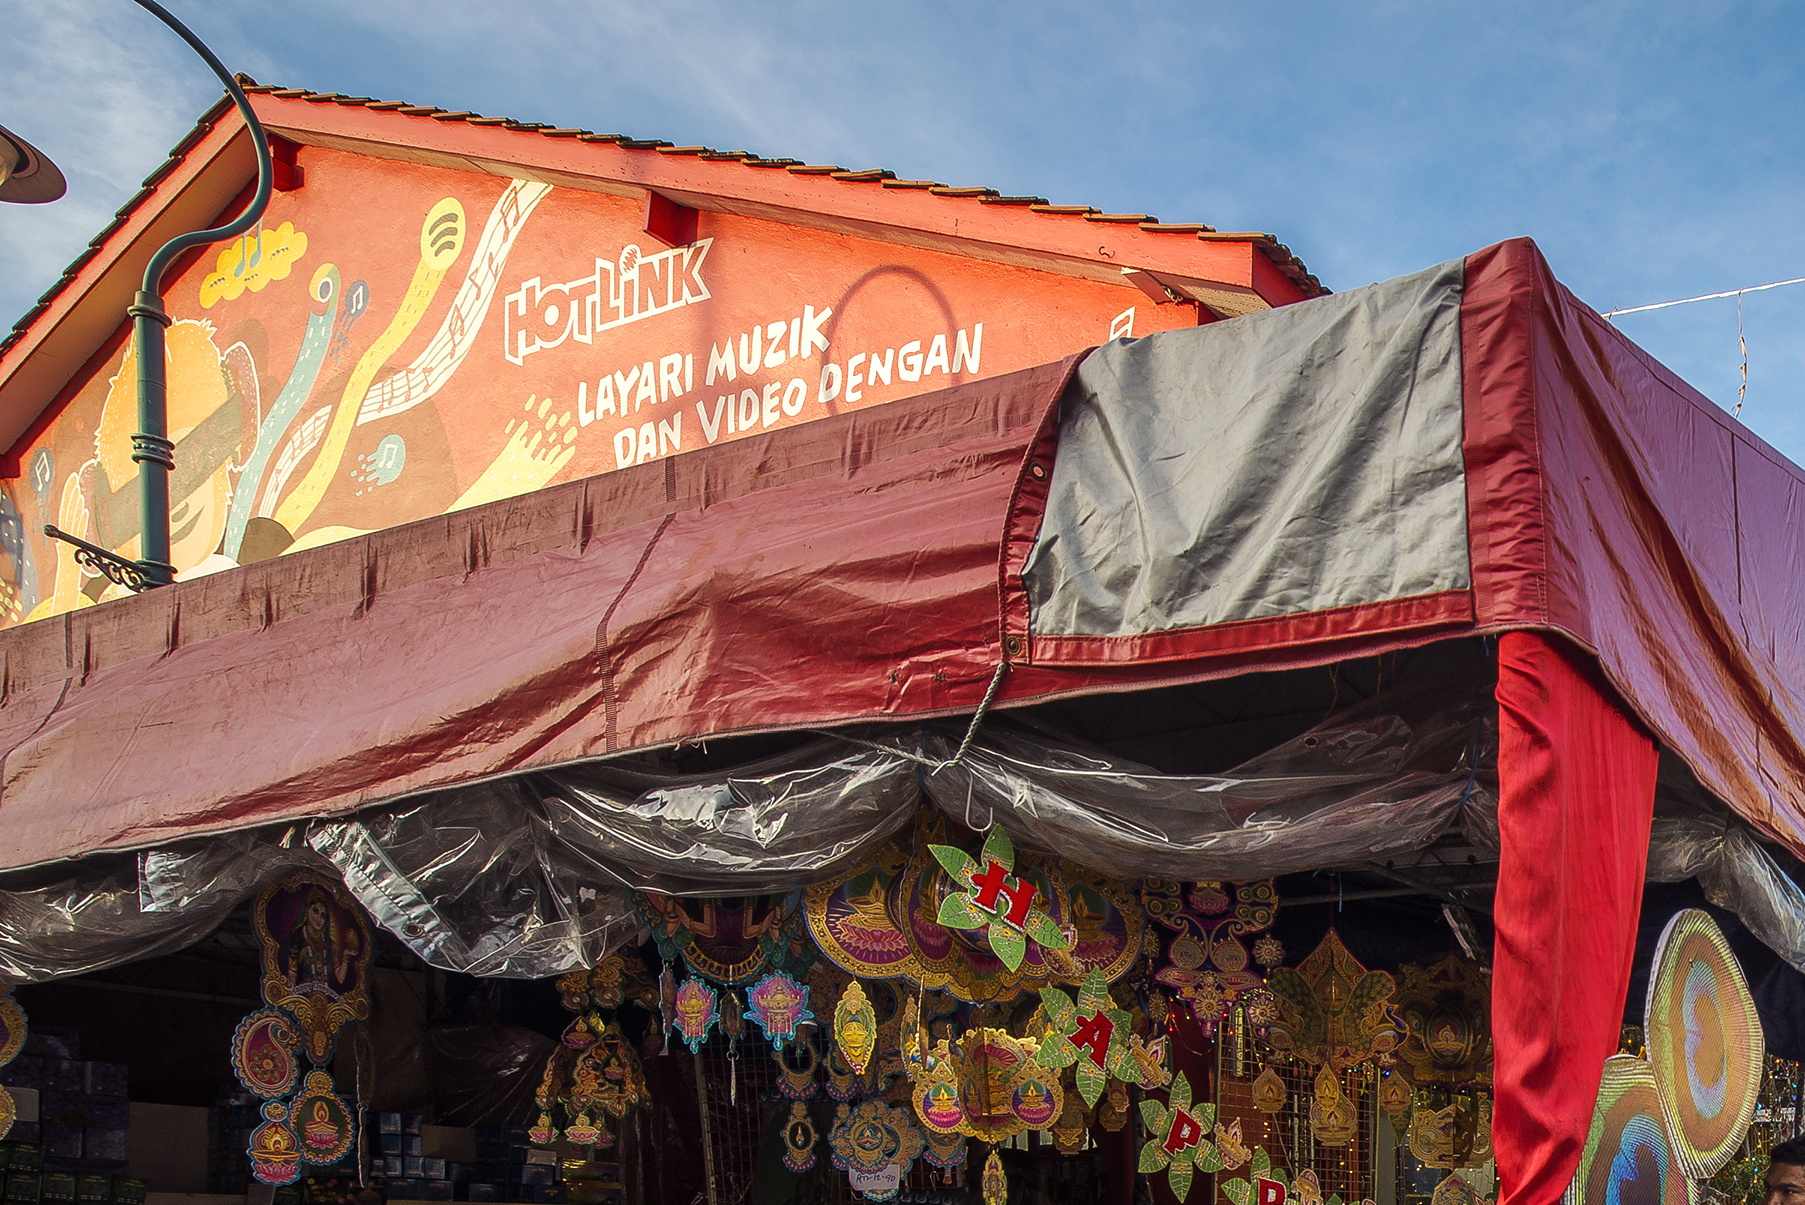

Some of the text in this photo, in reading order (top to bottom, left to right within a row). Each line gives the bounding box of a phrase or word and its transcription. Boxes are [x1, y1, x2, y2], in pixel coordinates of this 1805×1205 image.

[578, 304, 833, 428] LAYARI MUZIK
[613, 323, 983, 469] DAN VIDEO DENGAN
